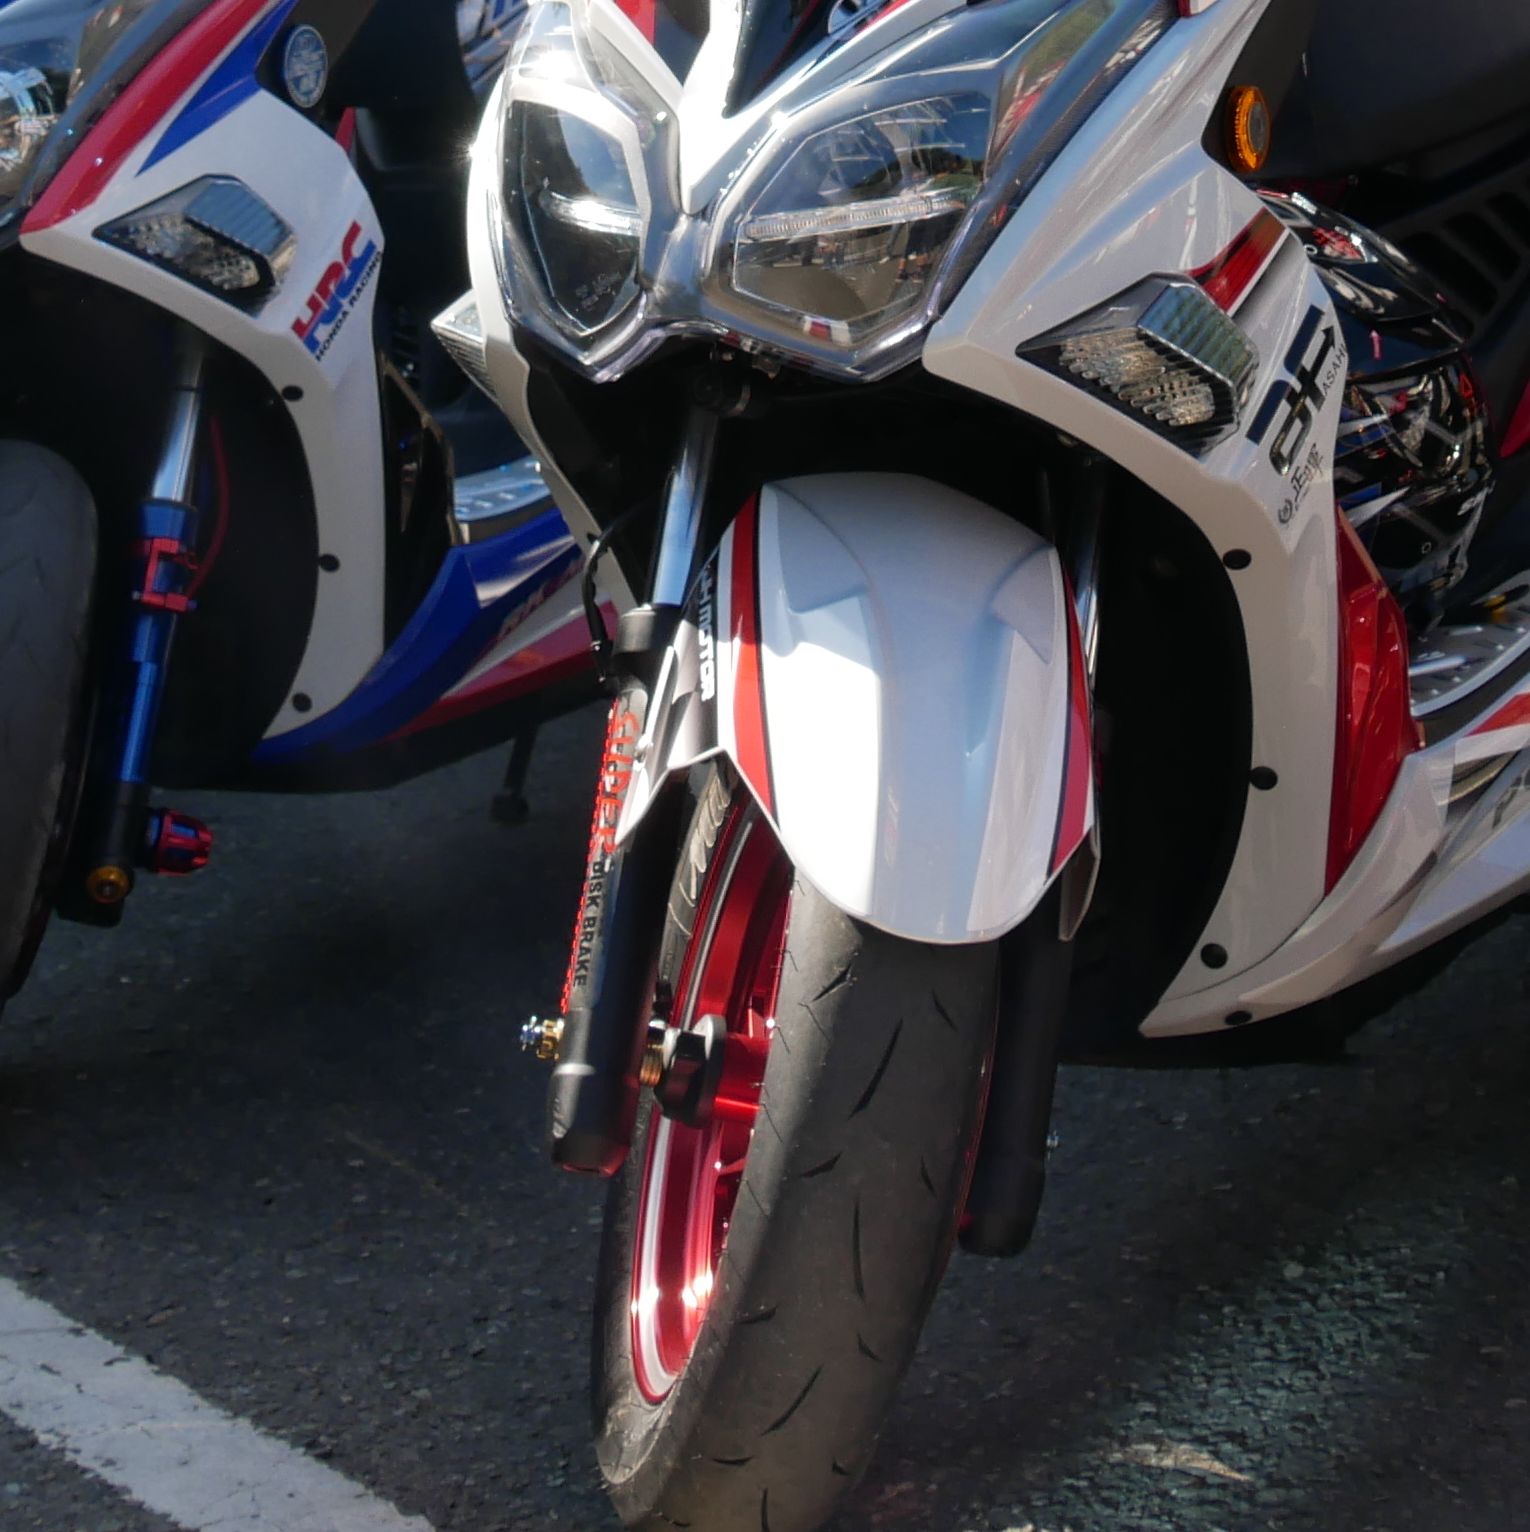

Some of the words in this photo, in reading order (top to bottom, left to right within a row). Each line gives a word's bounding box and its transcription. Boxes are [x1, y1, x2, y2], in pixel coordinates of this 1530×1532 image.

[290, 220, 378, 356] HRC
[314, 309, 350, 362] HONDA
[572, 916, 599, 988] BRAKE
